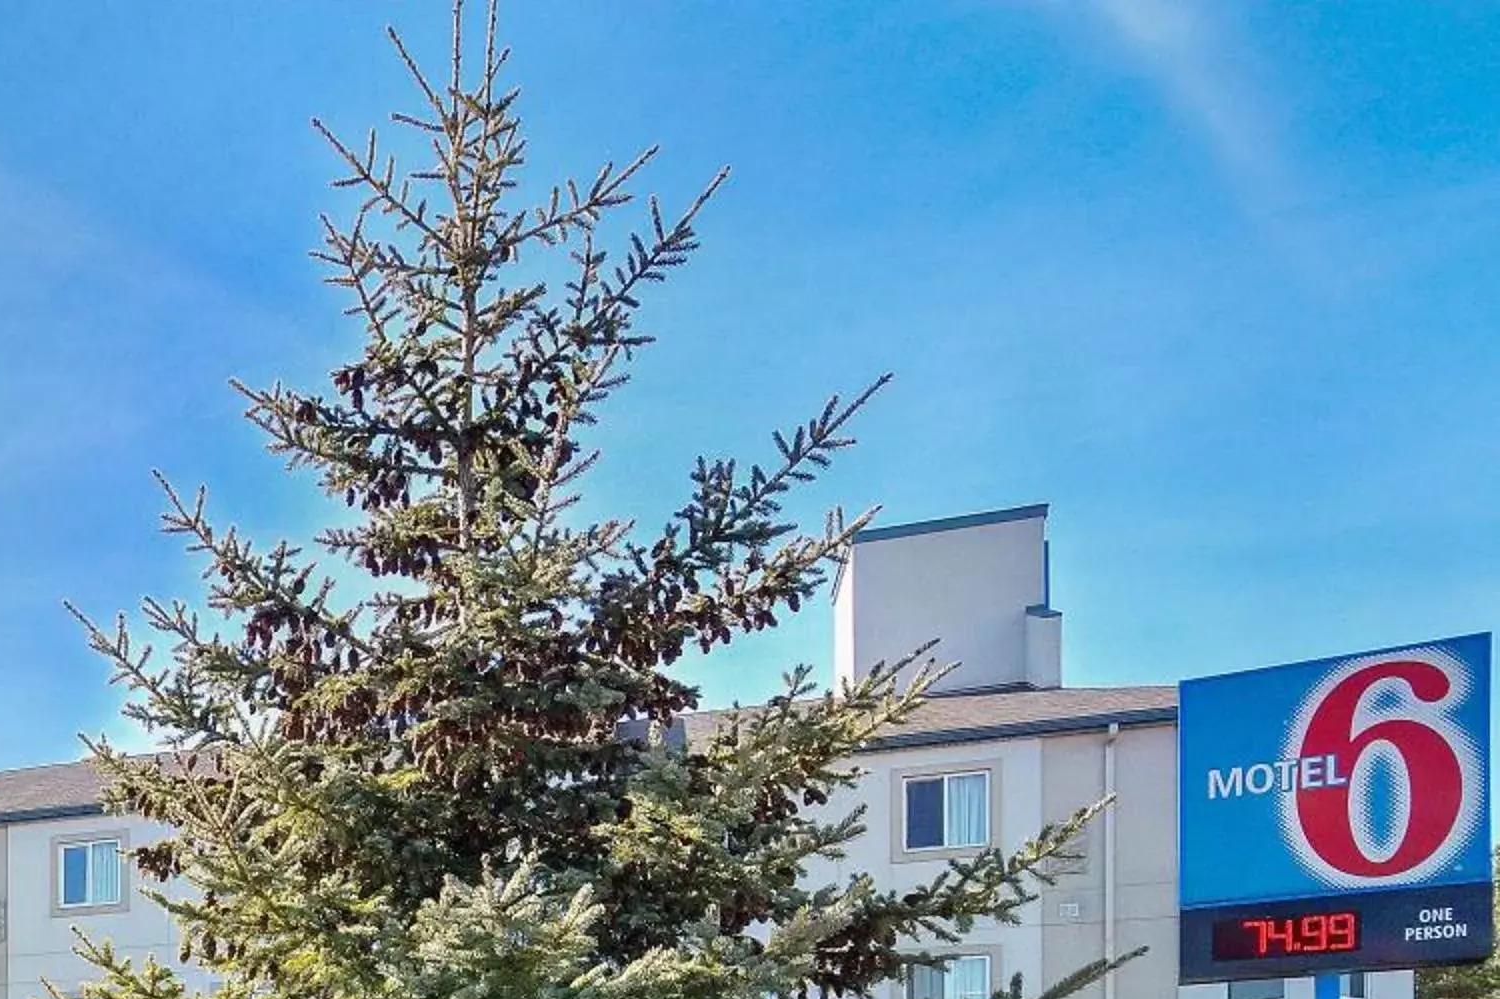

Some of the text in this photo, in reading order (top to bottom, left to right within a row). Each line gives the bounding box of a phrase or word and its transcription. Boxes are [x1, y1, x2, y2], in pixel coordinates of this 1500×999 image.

[1207, 661, 1463, 878] MOTEL 6
[1419, 907, 1453, 924] ONE
[1243, 913, 1356, 956] 74.99
[1404, 923, 1467, 941] PERSON
